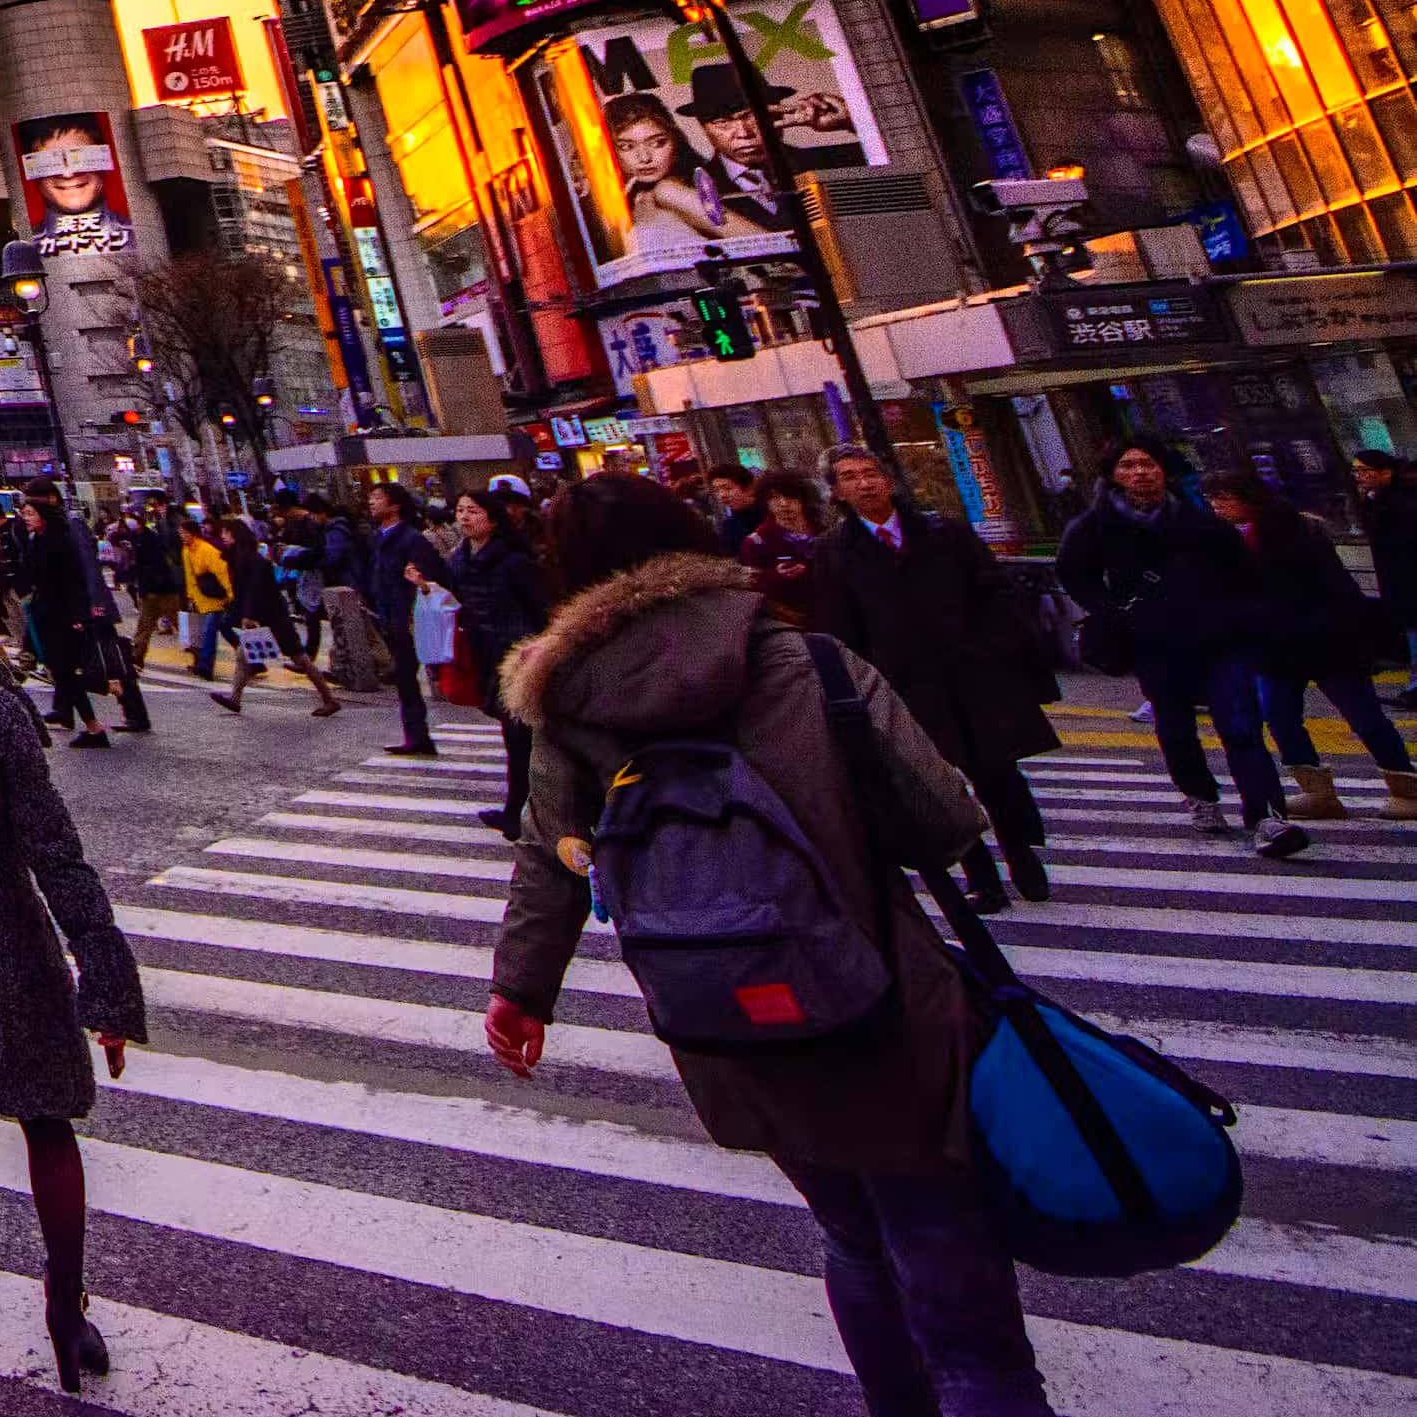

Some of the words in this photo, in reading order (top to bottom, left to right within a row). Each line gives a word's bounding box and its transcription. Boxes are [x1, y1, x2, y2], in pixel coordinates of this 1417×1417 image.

[163, 28, 215, 64] H&M
[191, 74, 234, 91] 150m
[55, 212, 103, 234] 楽天
[39, 228, 131, 257] カードマン
[1068, 318, 1155, 345] 渋谷駅
